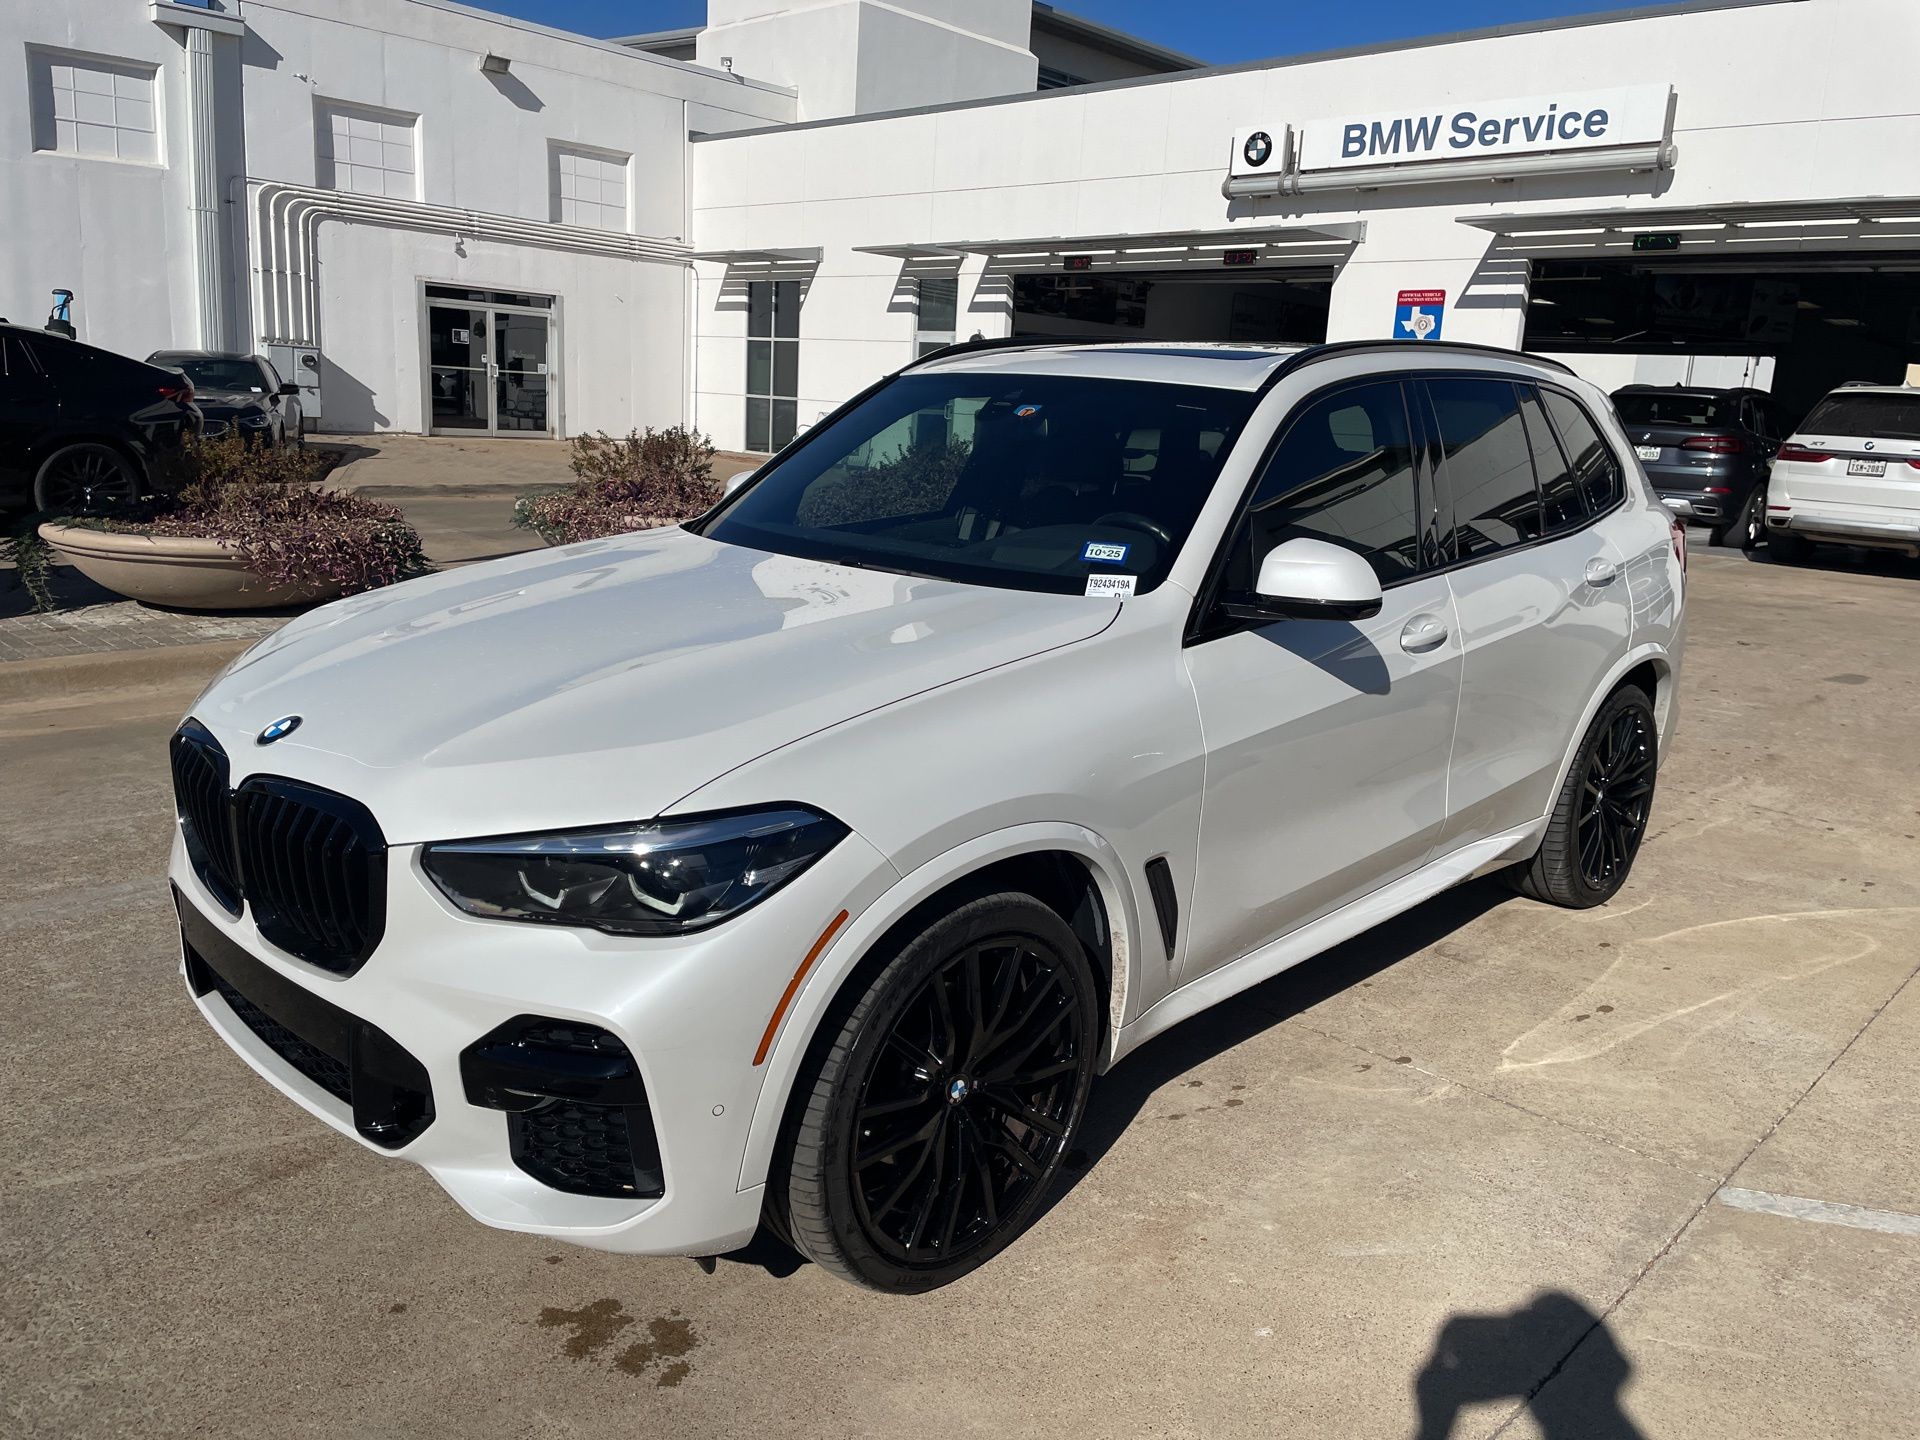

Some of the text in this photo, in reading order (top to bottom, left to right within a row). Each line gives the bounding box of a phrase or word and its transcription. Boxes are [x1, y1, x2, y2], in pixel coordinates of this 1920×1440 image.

[1342, 103, 1608, 158] BMW Service
[1089, 579, 1130, 589] T9243419A
